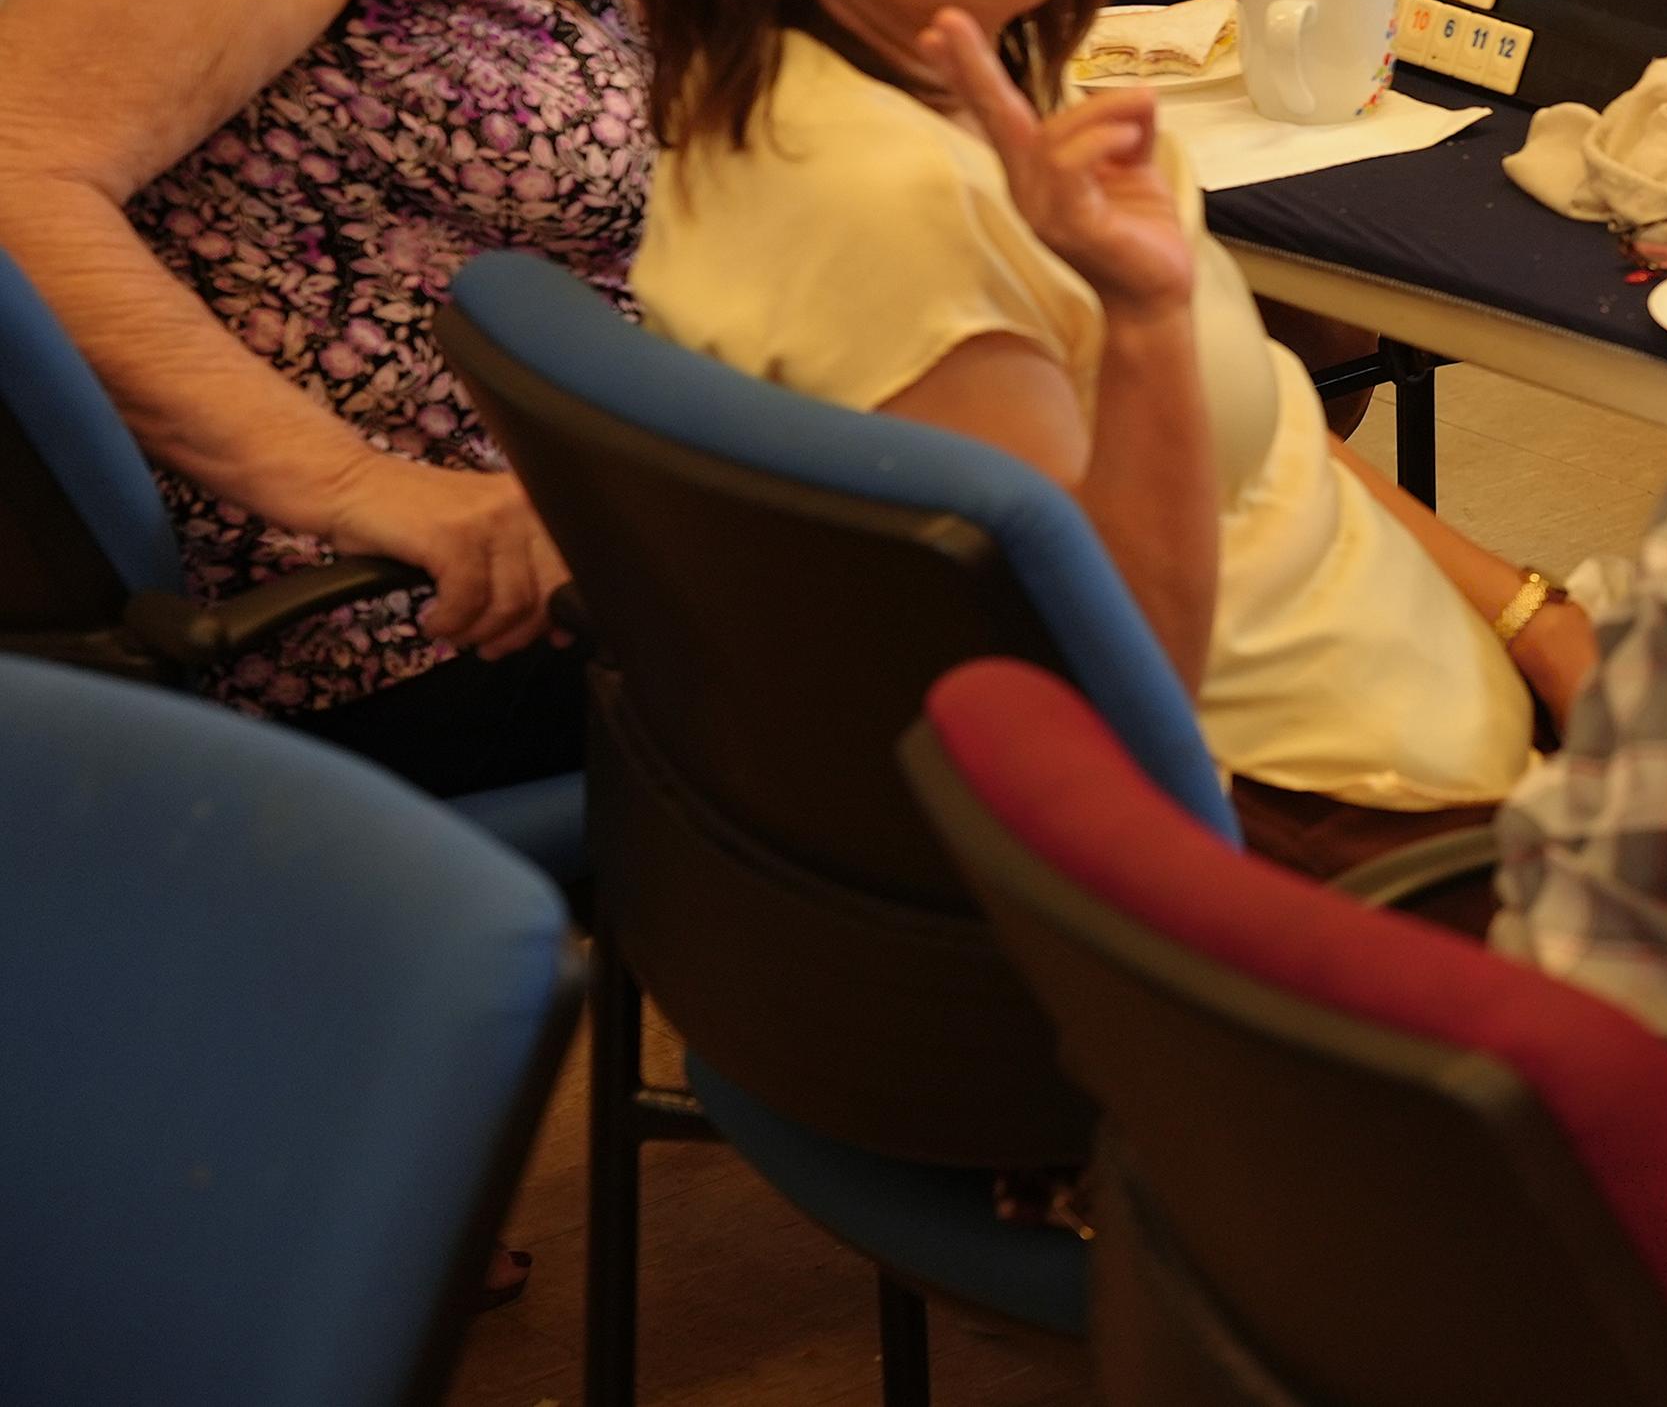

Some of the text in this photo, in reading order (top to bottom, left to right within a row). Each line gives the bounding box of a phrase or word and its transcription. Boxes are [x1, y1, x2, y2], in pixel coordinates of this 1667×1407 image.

[1412, 8, 1516, 58] 10 6 11 12
